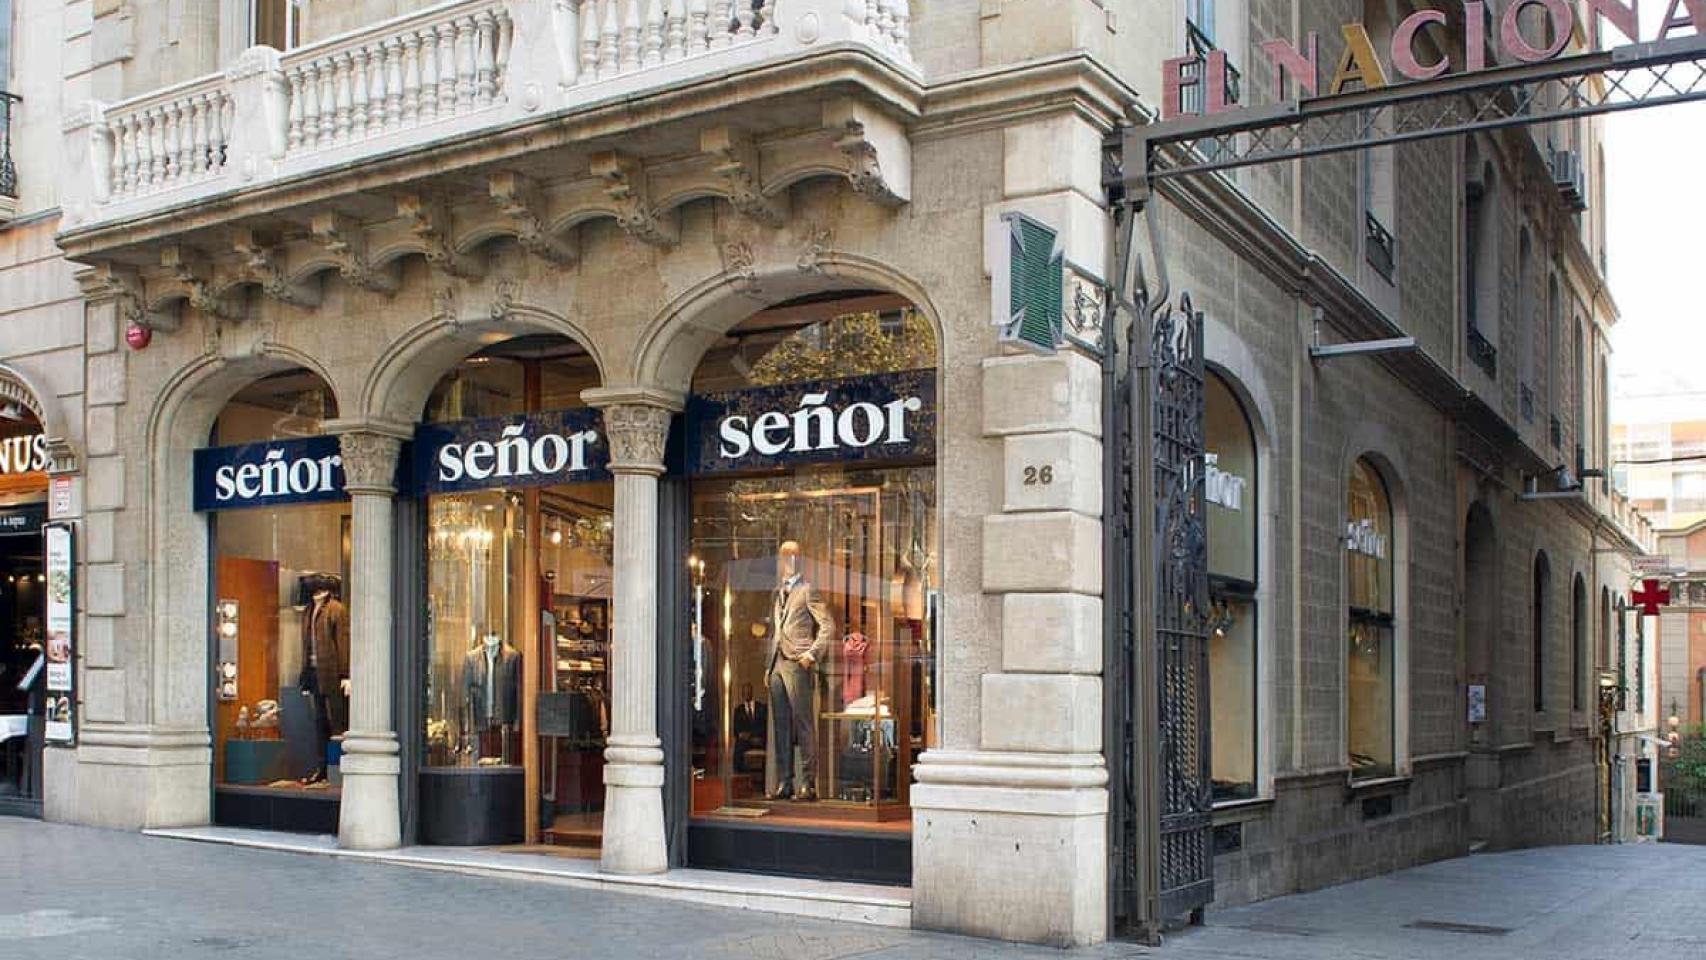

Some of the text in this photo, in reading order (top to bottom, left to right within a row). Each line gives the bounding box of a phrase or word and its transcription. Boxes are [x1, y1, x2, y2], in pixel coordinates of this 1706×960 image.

[1161, 49, 1242, 121] EL
[438, 421, 598, 482] señor
[718, 391, 922, 458] señor
[215, 447, 342, 501] señor
[1023, 464, 1053, 486] 26
